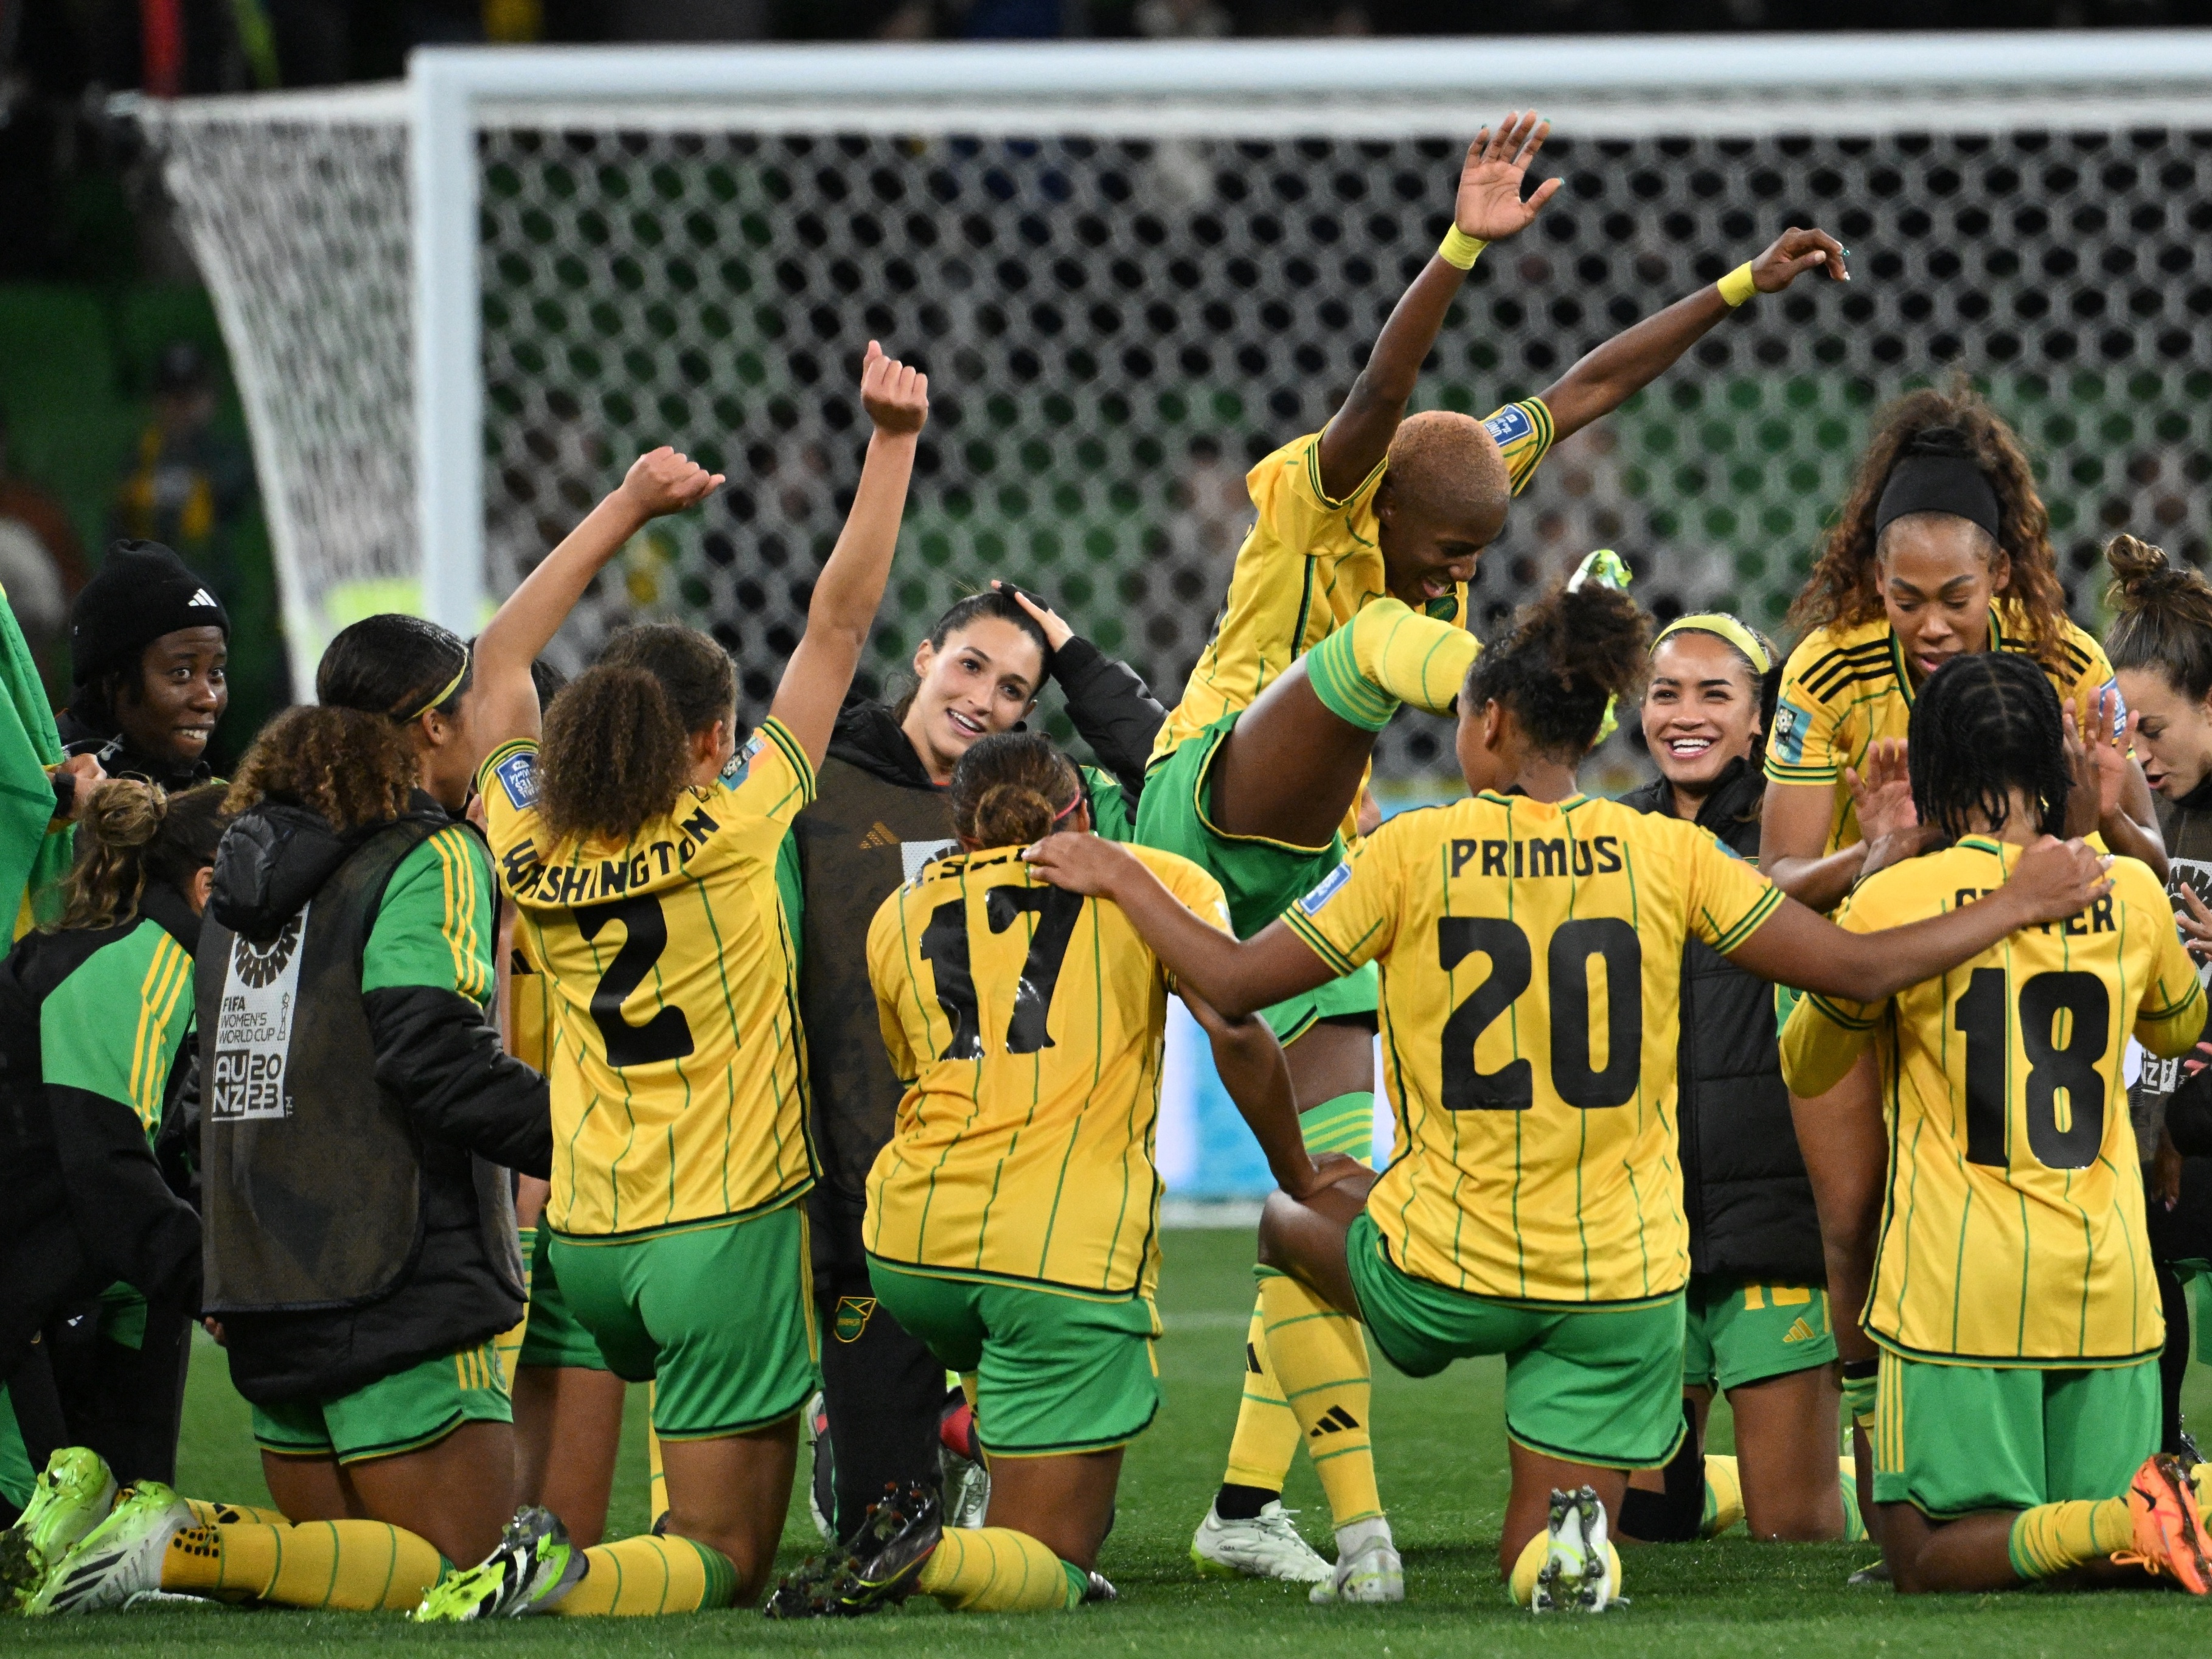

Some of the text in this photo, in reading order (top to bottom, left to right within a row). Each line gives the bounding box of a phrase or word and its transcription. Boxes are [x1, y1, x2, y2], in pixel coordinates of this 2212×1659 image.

[502, 805, 720, 903] WASHINGTON
[1450, 835, 1622, 878] PRIMUS
[572, 894, 695, 1067] 2
[920, 885, 1084, 1061] 17
[220, 1012, 267, 1028] WOMEN'S
[222, 995, 246, 1012] FIFA
[1437, 916, 1642, 1111] 20
[218, 1027, 275, 1044] WORLD CUP
[215, 1053, 282, 1083] AU 20
[1954, 967, 2110, 1169] 18
[213, 1082, 279, 1113] NZ 23
